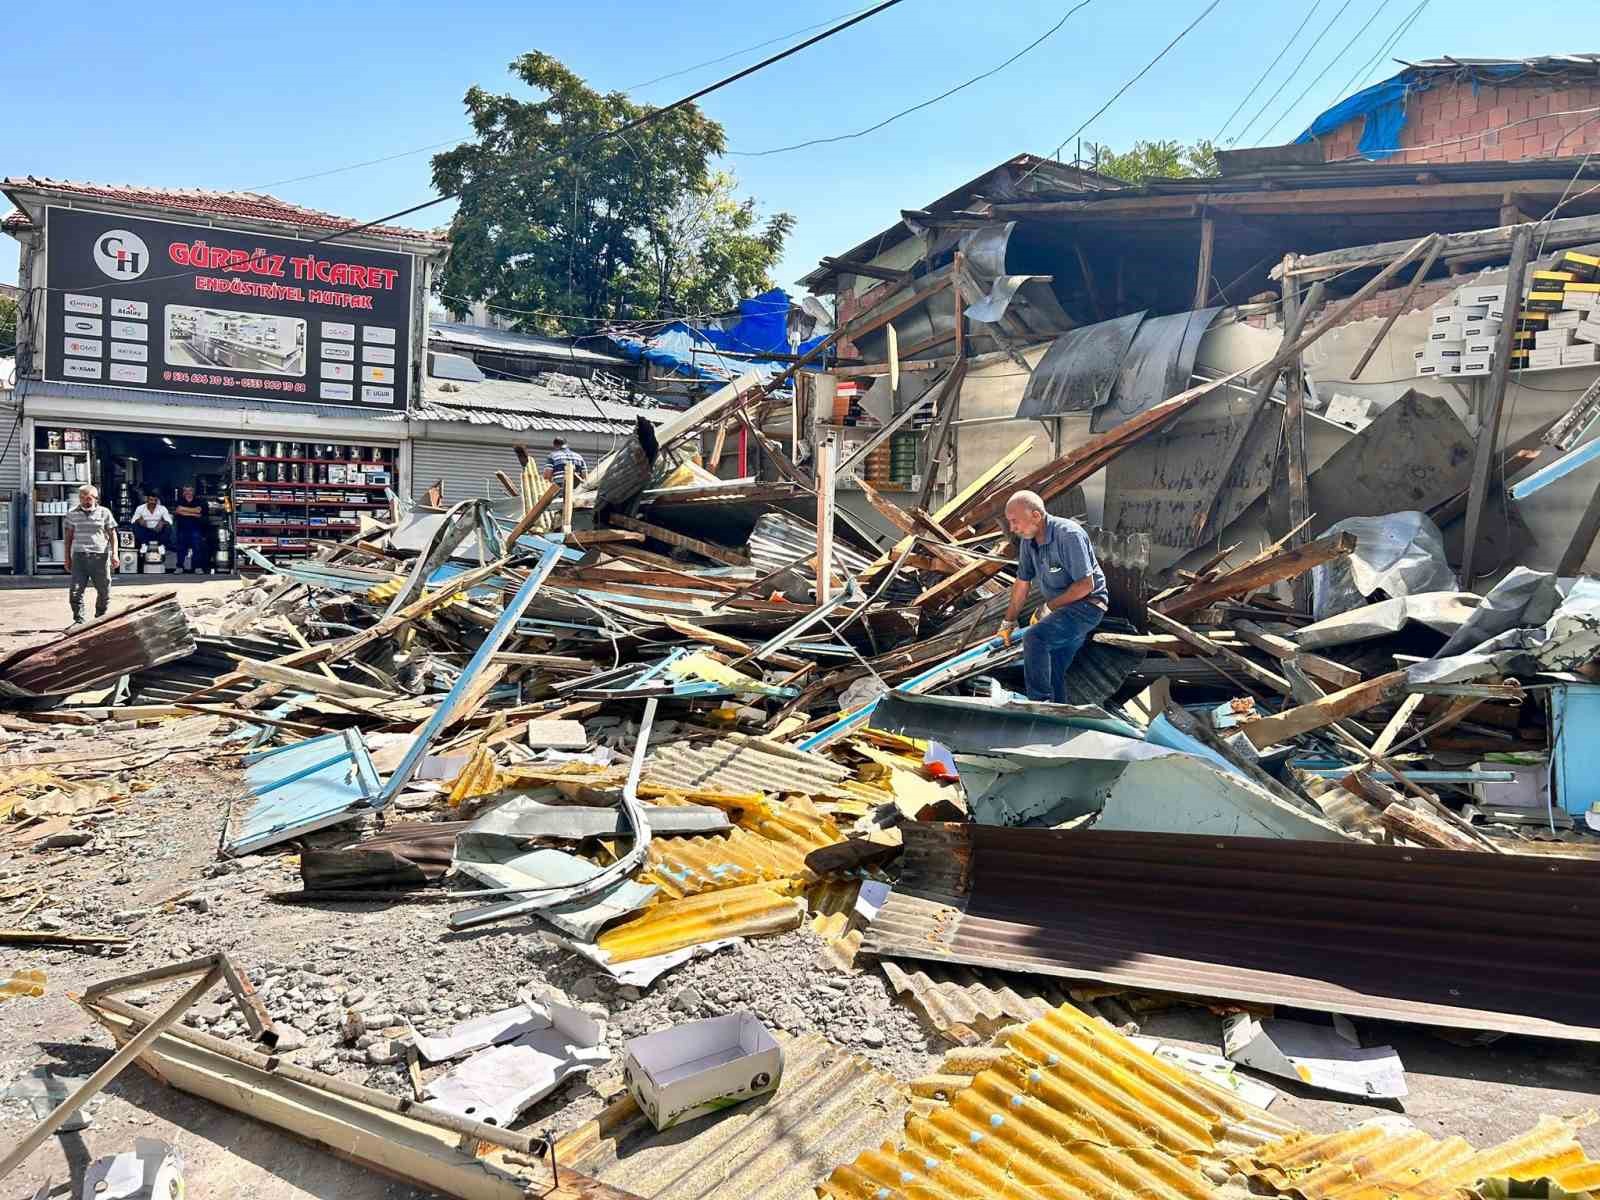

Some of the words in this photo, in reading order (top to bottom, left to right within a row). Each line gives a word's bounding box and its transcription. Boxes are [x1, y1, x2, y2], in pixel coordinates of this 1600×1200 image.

[169, 240, 286, 277] GÜRBÜZ
[289, 254, 399, 290] TİCARET
[195, 276, 305, 302] ENDÜSTRİYEL
[308, 289, 374, 310] MUTFAK
